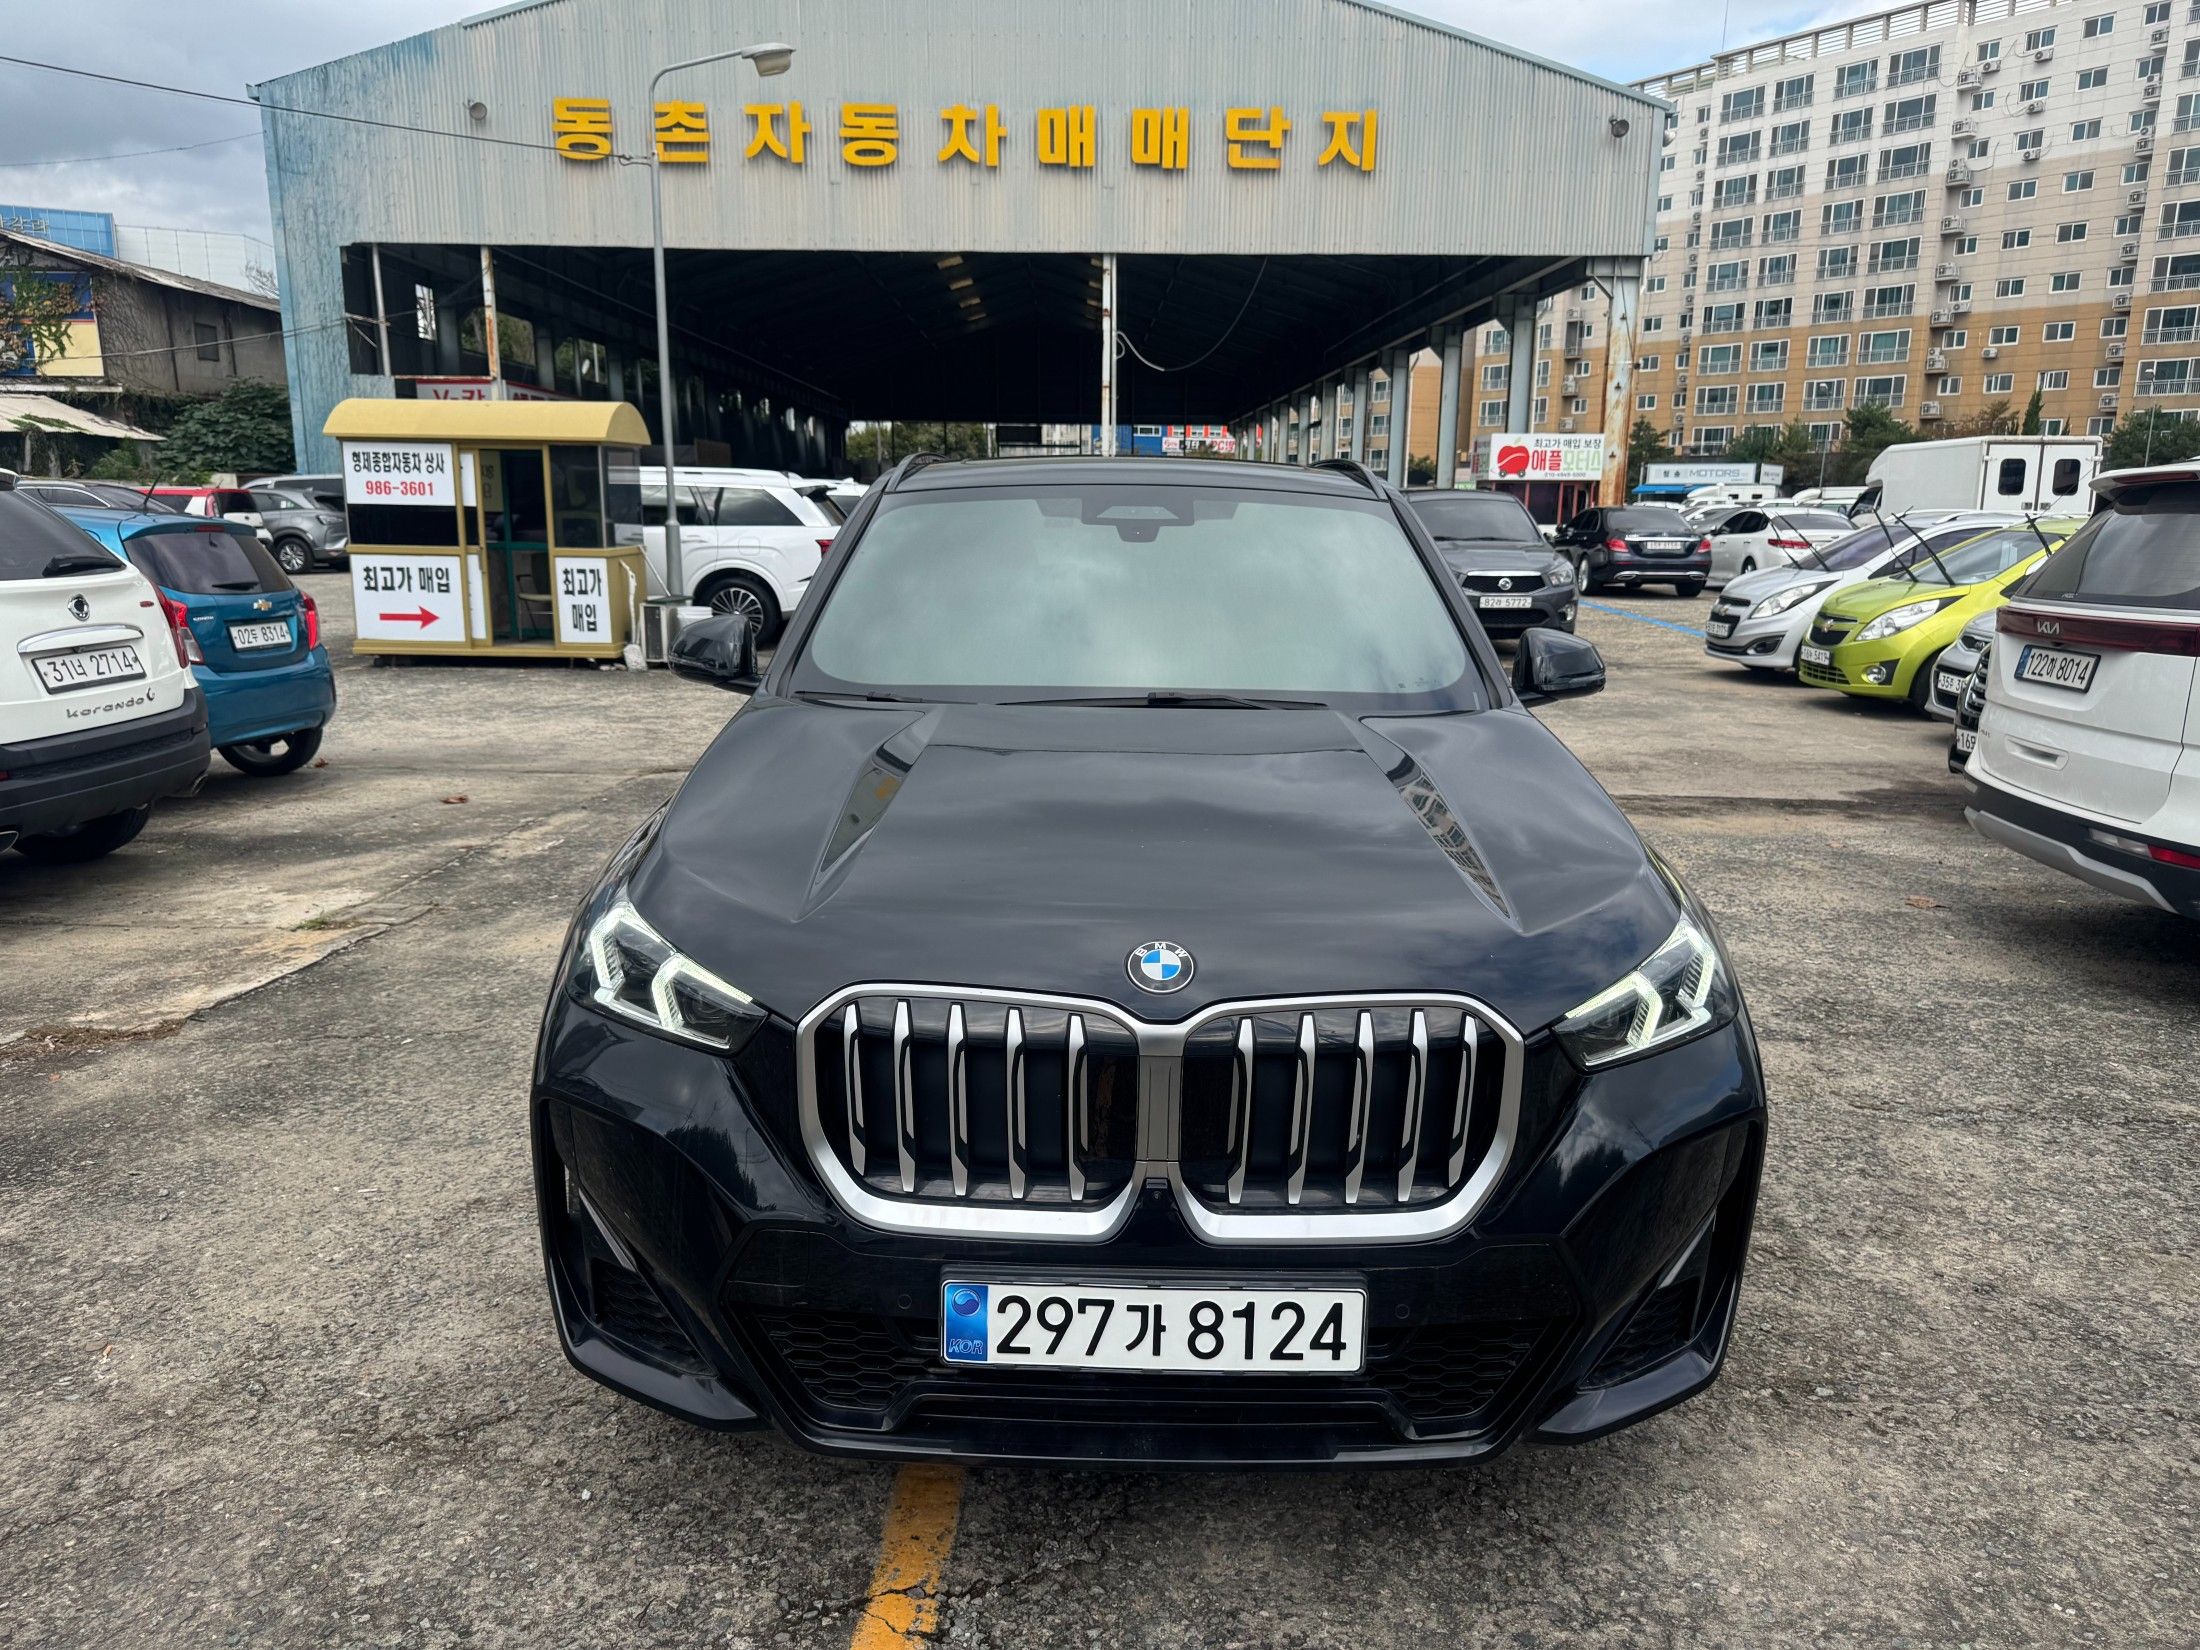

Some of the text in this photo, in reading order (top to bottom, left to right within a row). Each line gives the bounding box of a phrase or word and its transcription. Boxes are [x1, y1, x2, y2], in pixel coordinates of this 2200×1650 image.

[352, 452, 445, 474] 형제종합자동차 상사
[1531, 449, 1601, 471] 애플모터스
[1689, 469, 1740, 477] MOTORS
[365, 480, 434, 497] 986-3601
[363, 566, 451, 593] 최고가 매입
[563, 568, 602, 597] 최고가
[1505, 598, 1528, 607] 5772
[571, 603, 597, 632] 매입
[260, 624, 286, 642] 8314
[47, 650, 135, 682] 31너 2714
[2056, 657, 2091, 684] 8014
[1134, 942, 1188, 958] BMW
[995, 1294, 1347, 1361] 297가 8124
[948, 1338, 984, 1355] KOR
